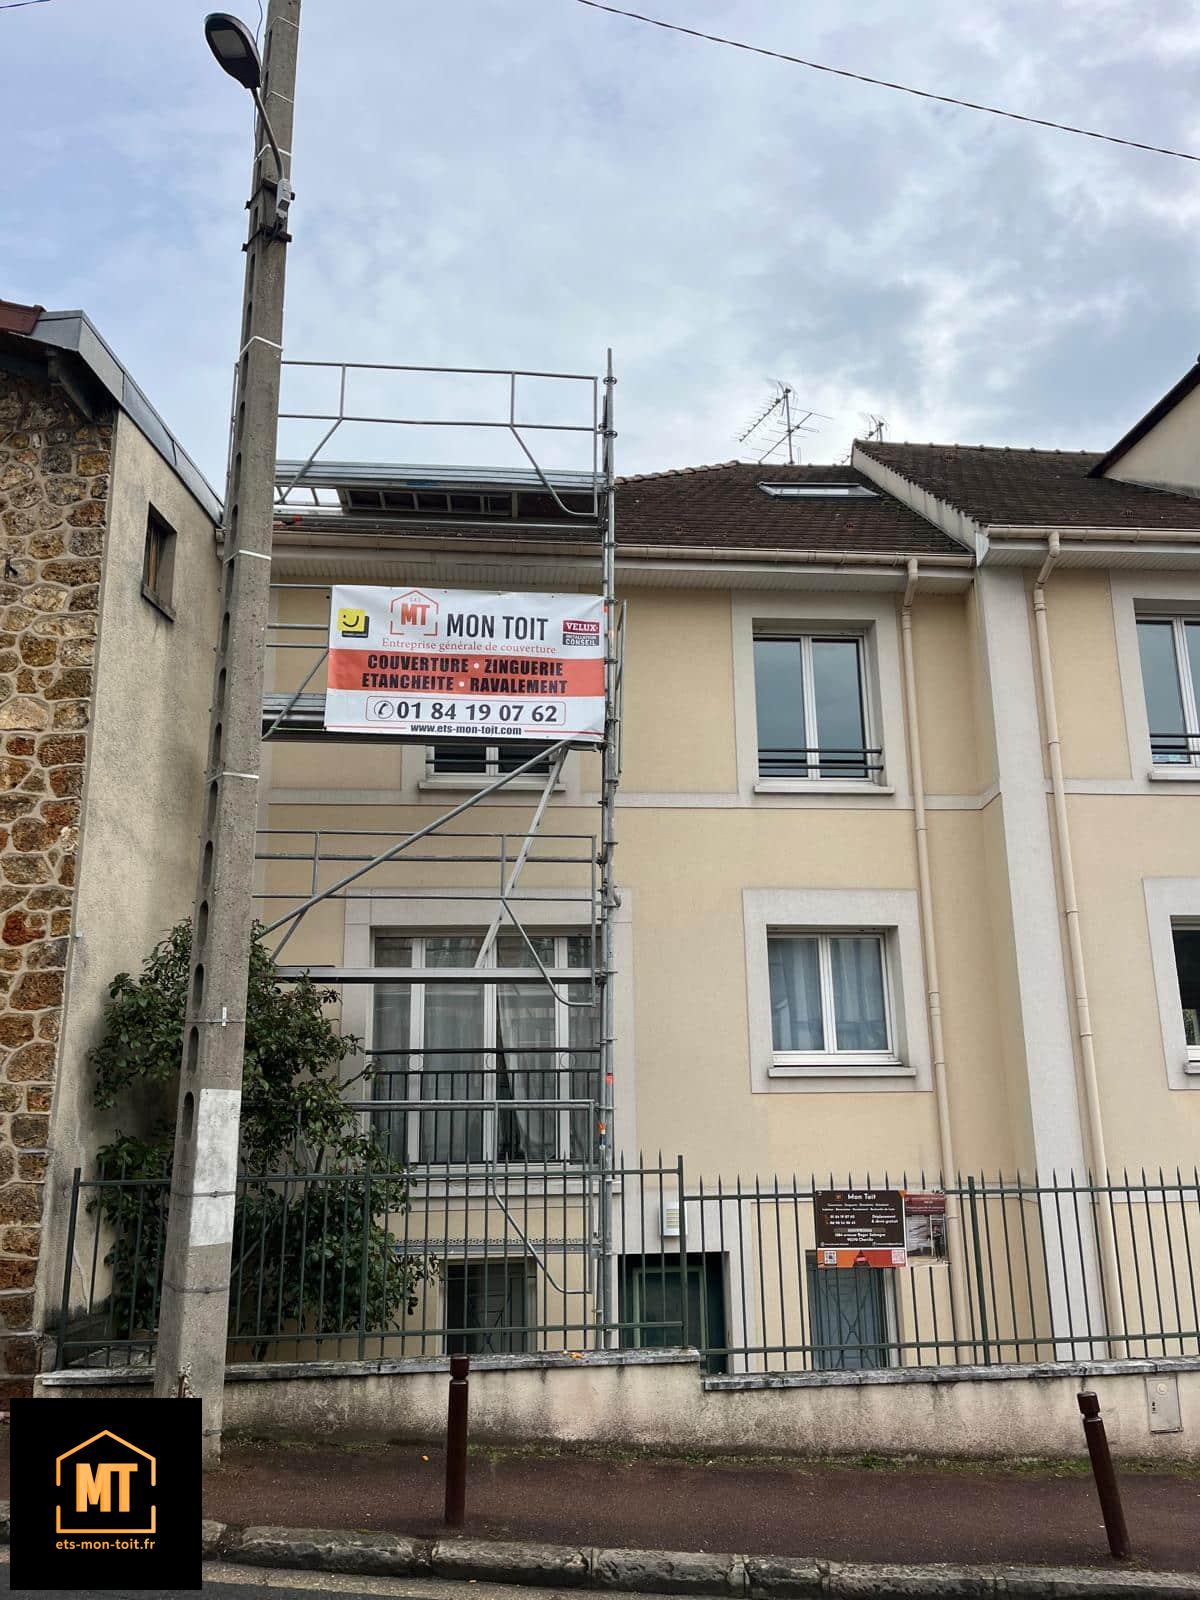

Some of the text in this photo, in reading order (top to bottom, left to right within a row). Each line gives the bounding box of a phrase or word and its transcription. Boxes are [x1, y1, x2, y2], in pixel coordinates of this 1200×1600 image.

[401, 603, 431, 626] MT
[446, 613, 549, 641] MON TOIT
[565, 621, 596, 633] VELUX
[382, 638, 558, 655] Entreprise générale de couverture
[367, 654, 564, 677] COUVERTURE ZINGUERIE
[361, 672, 568, 694] ETANCHEITE RAVALEMENT
[396, 701, 557, 723] 01 84 19 07 62
[410, 723, 522, 736] www.ets-mon-toit.com
